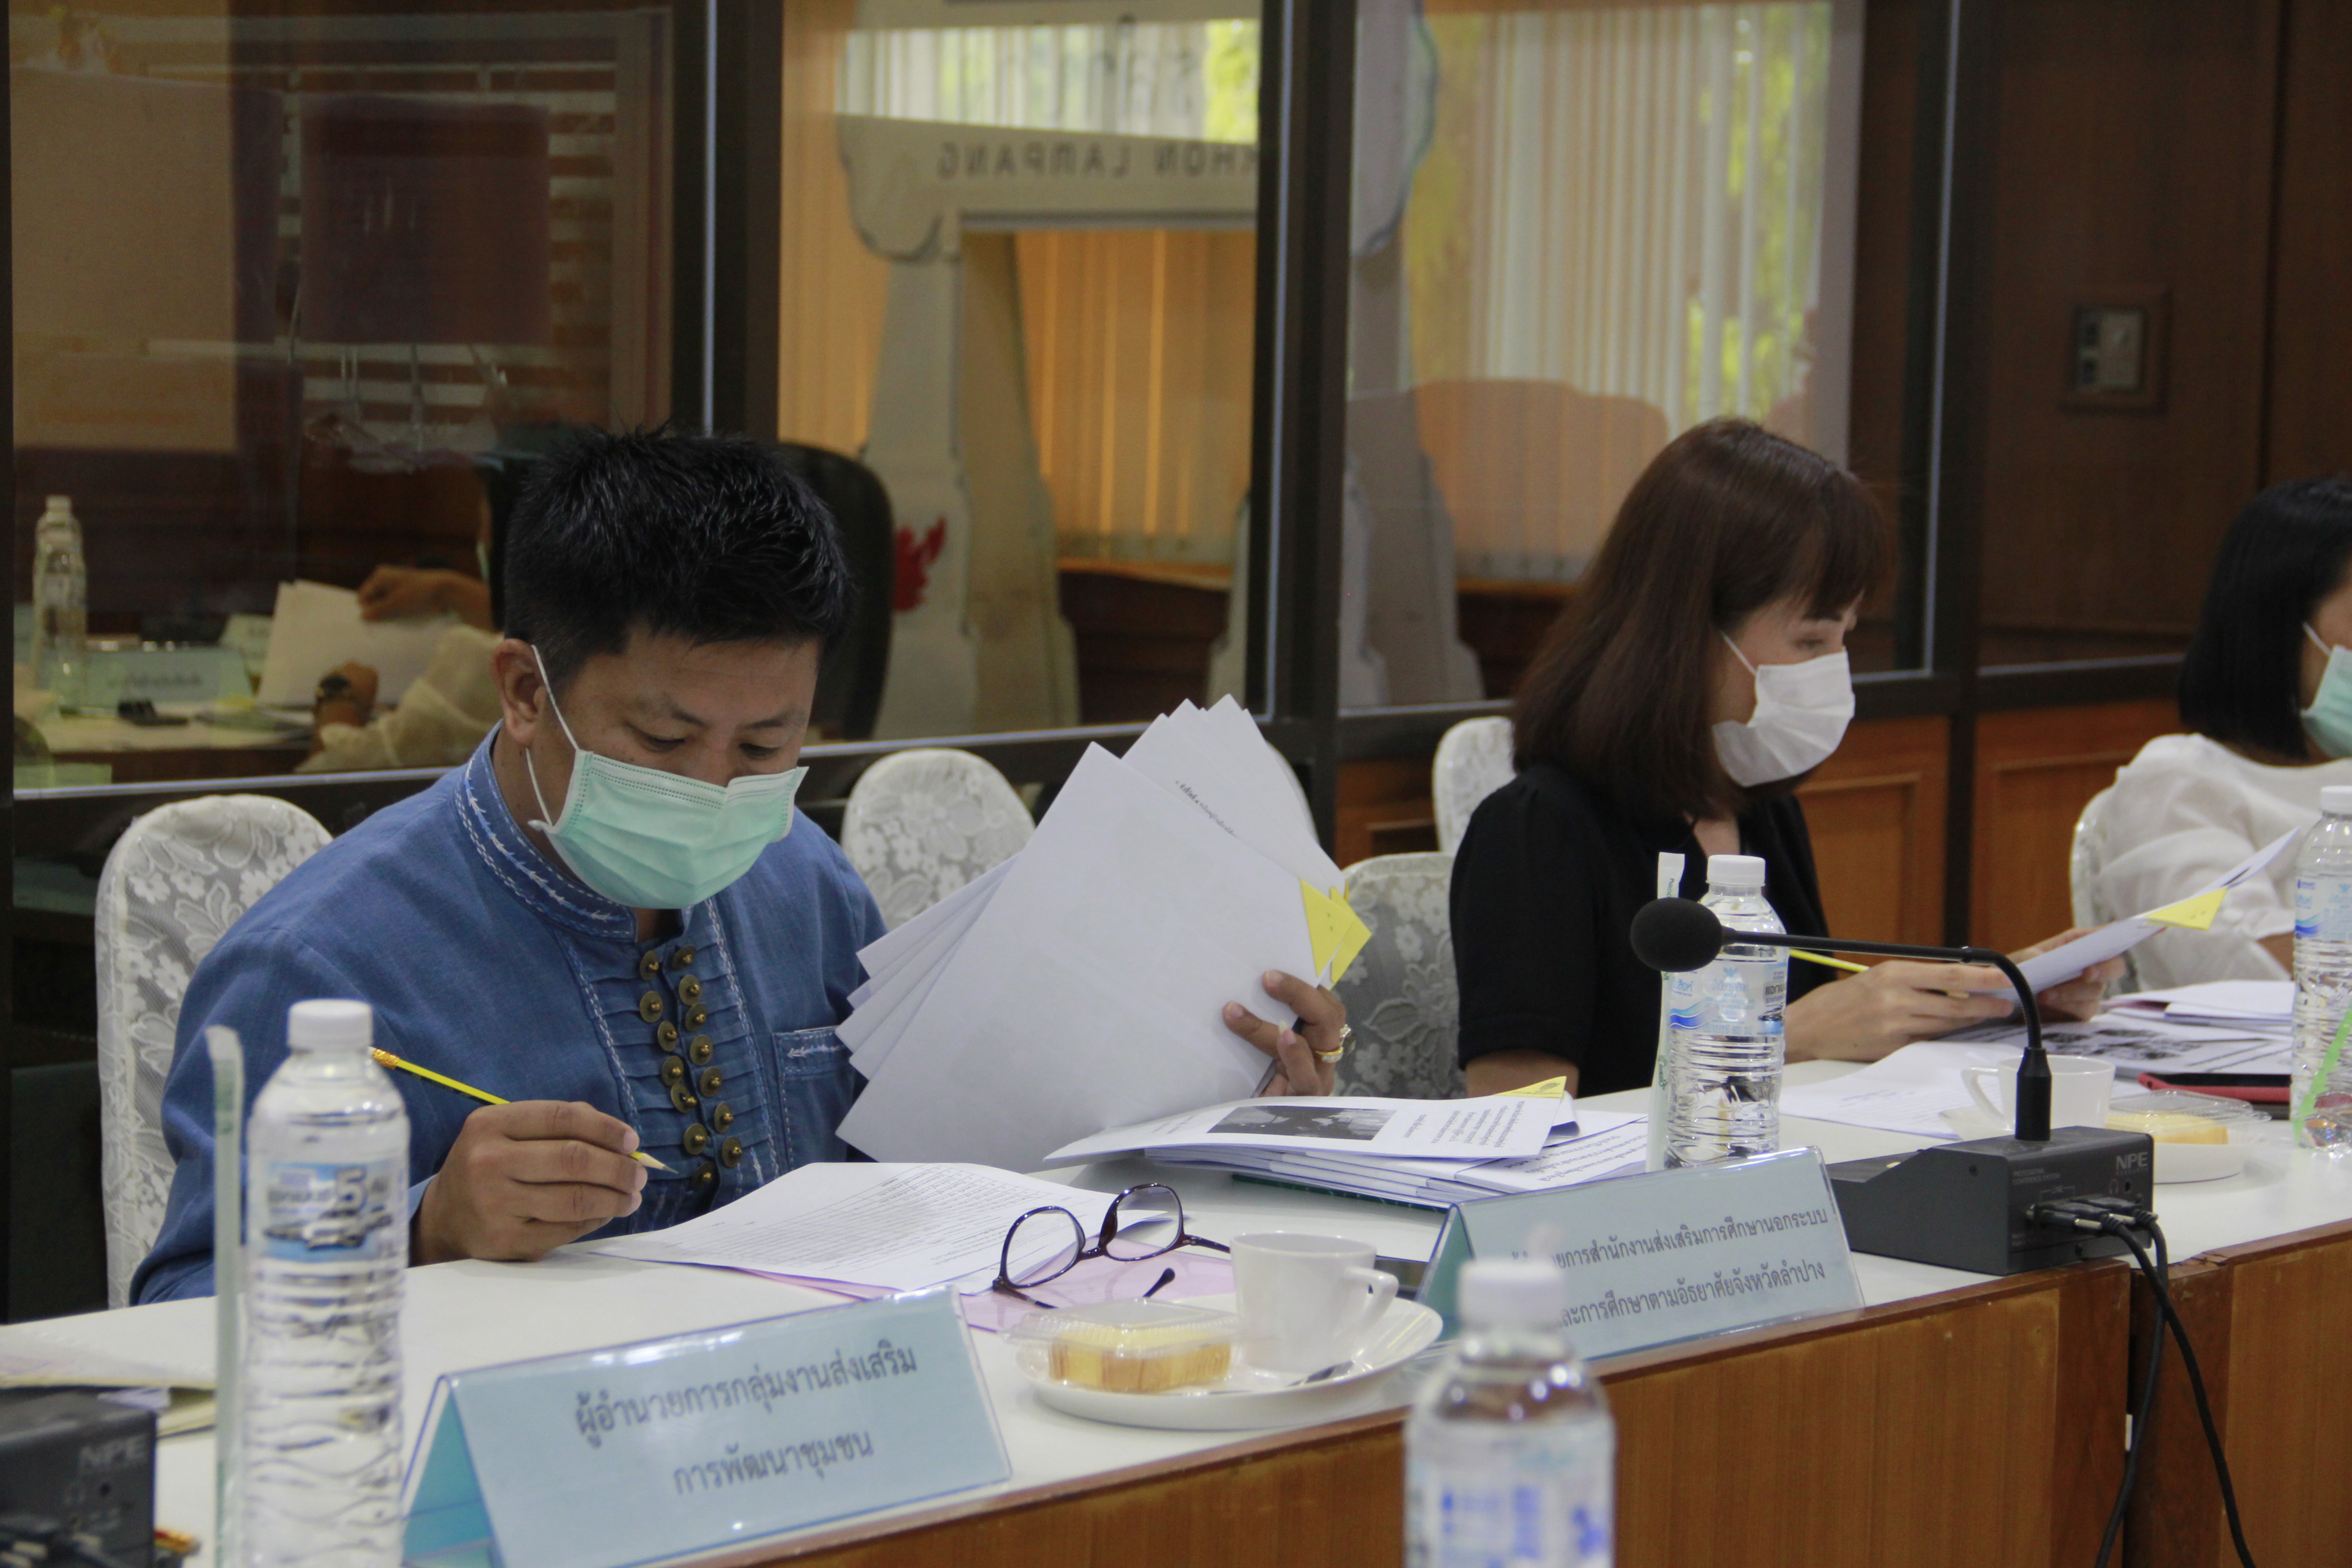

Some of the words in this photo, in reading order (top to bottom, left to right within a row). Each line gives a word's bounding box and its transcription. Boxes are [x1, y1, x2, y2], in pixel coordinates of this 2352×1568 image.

[2116, 1152, 2148, 1170] NPE
[1512, 1208, 1828, 1268] ยการสำนักงานส่งเสริมการศึกษานอกระบบ
[1559, 1259, 1826, 1328] ละการศึกษาตามอัธยาศัยจังหวัดลำปาง
[575, 1339, 917, 1447] ผู้อำนวยการกลุ่มงานส่งเสริม
[673, 1430, 874, 1494] การพัฒนาชุมชน
